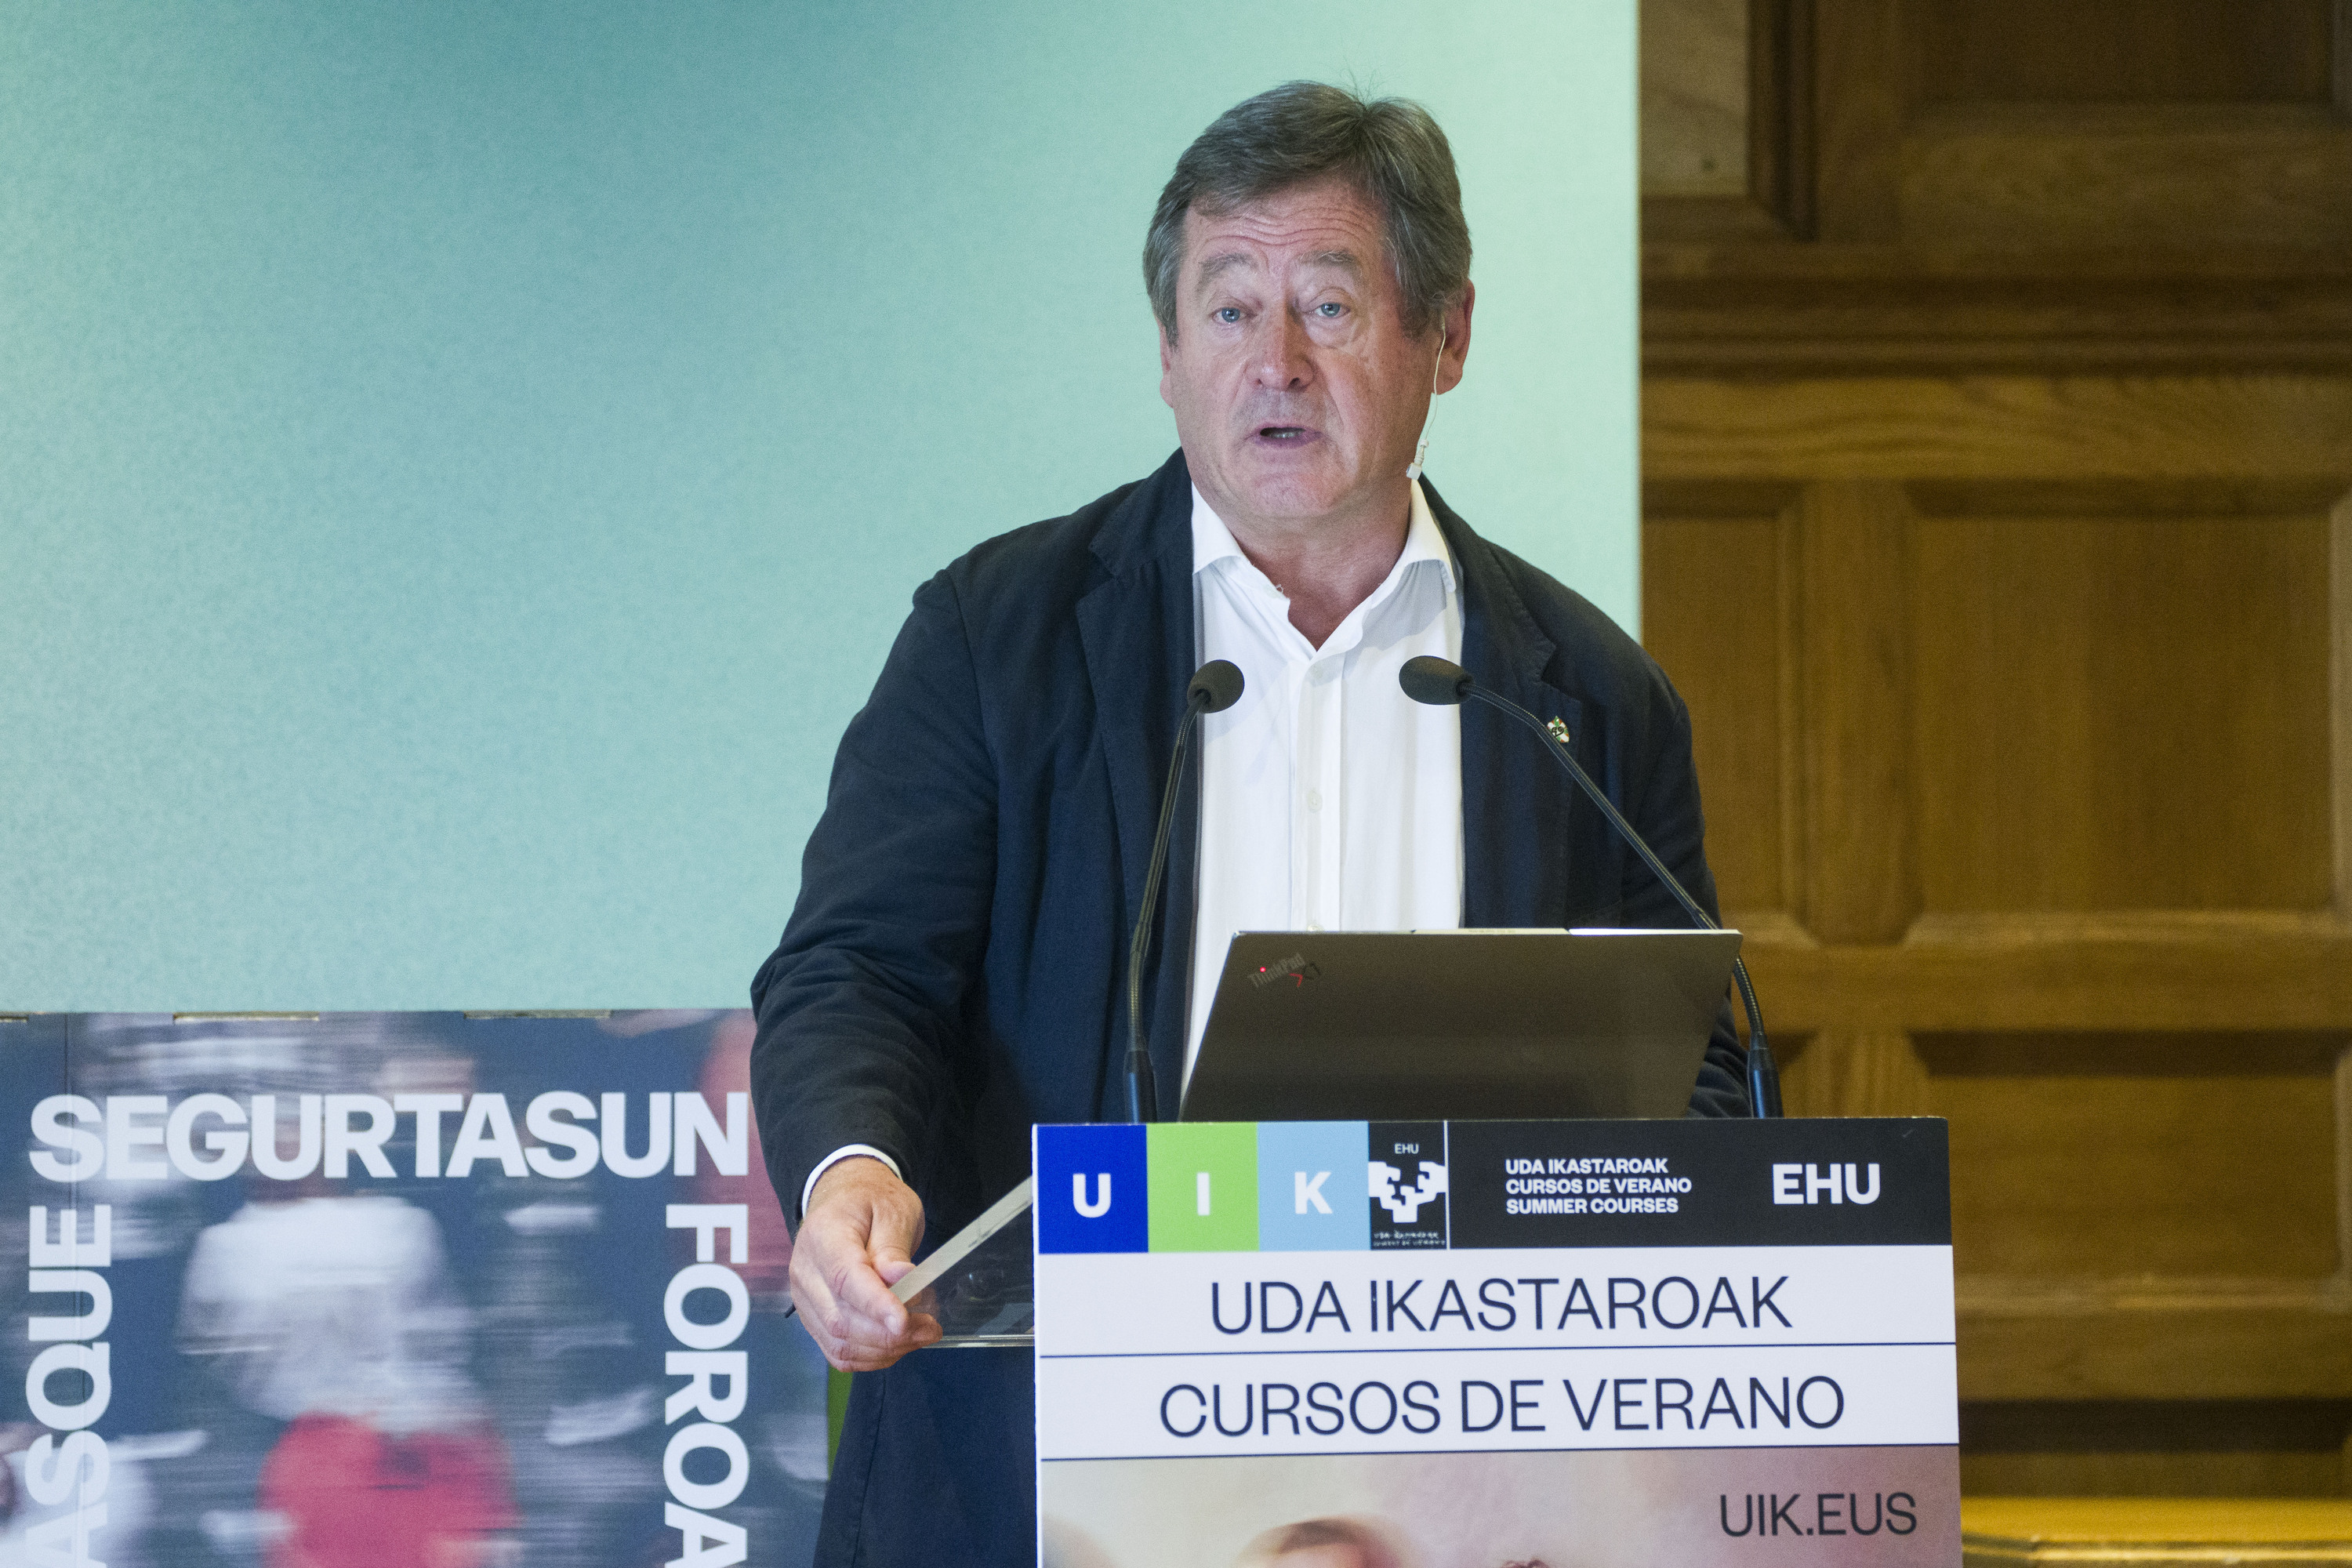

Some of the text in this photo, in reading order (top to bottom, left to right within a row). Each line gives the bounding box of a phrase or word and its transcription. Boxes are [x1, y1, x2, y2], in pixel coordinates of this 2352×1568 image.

[29, 1091, 749, 1181] SEGURTASUN
[1394, 1143, 1419, 1155] EHU
[1505, 1158, 1668, 1174] UDA IKASTAROAK
[1505, 1178, 1692, 1194] CURSOS DE VERANO
[1773, 1163, 1881, 1205] EHU
[1506, 1198, 1679, 1214] SUMMER COURSES
[1211, 1276, 1793, 1334] UDA IKASTAROAK
[663, 1204, 750, 1568] FOROA
[1160, 1375, 1845, 1438] CURSOS DE VERANO
[1720, 1492, 1918, 1537] UIK.EUS
